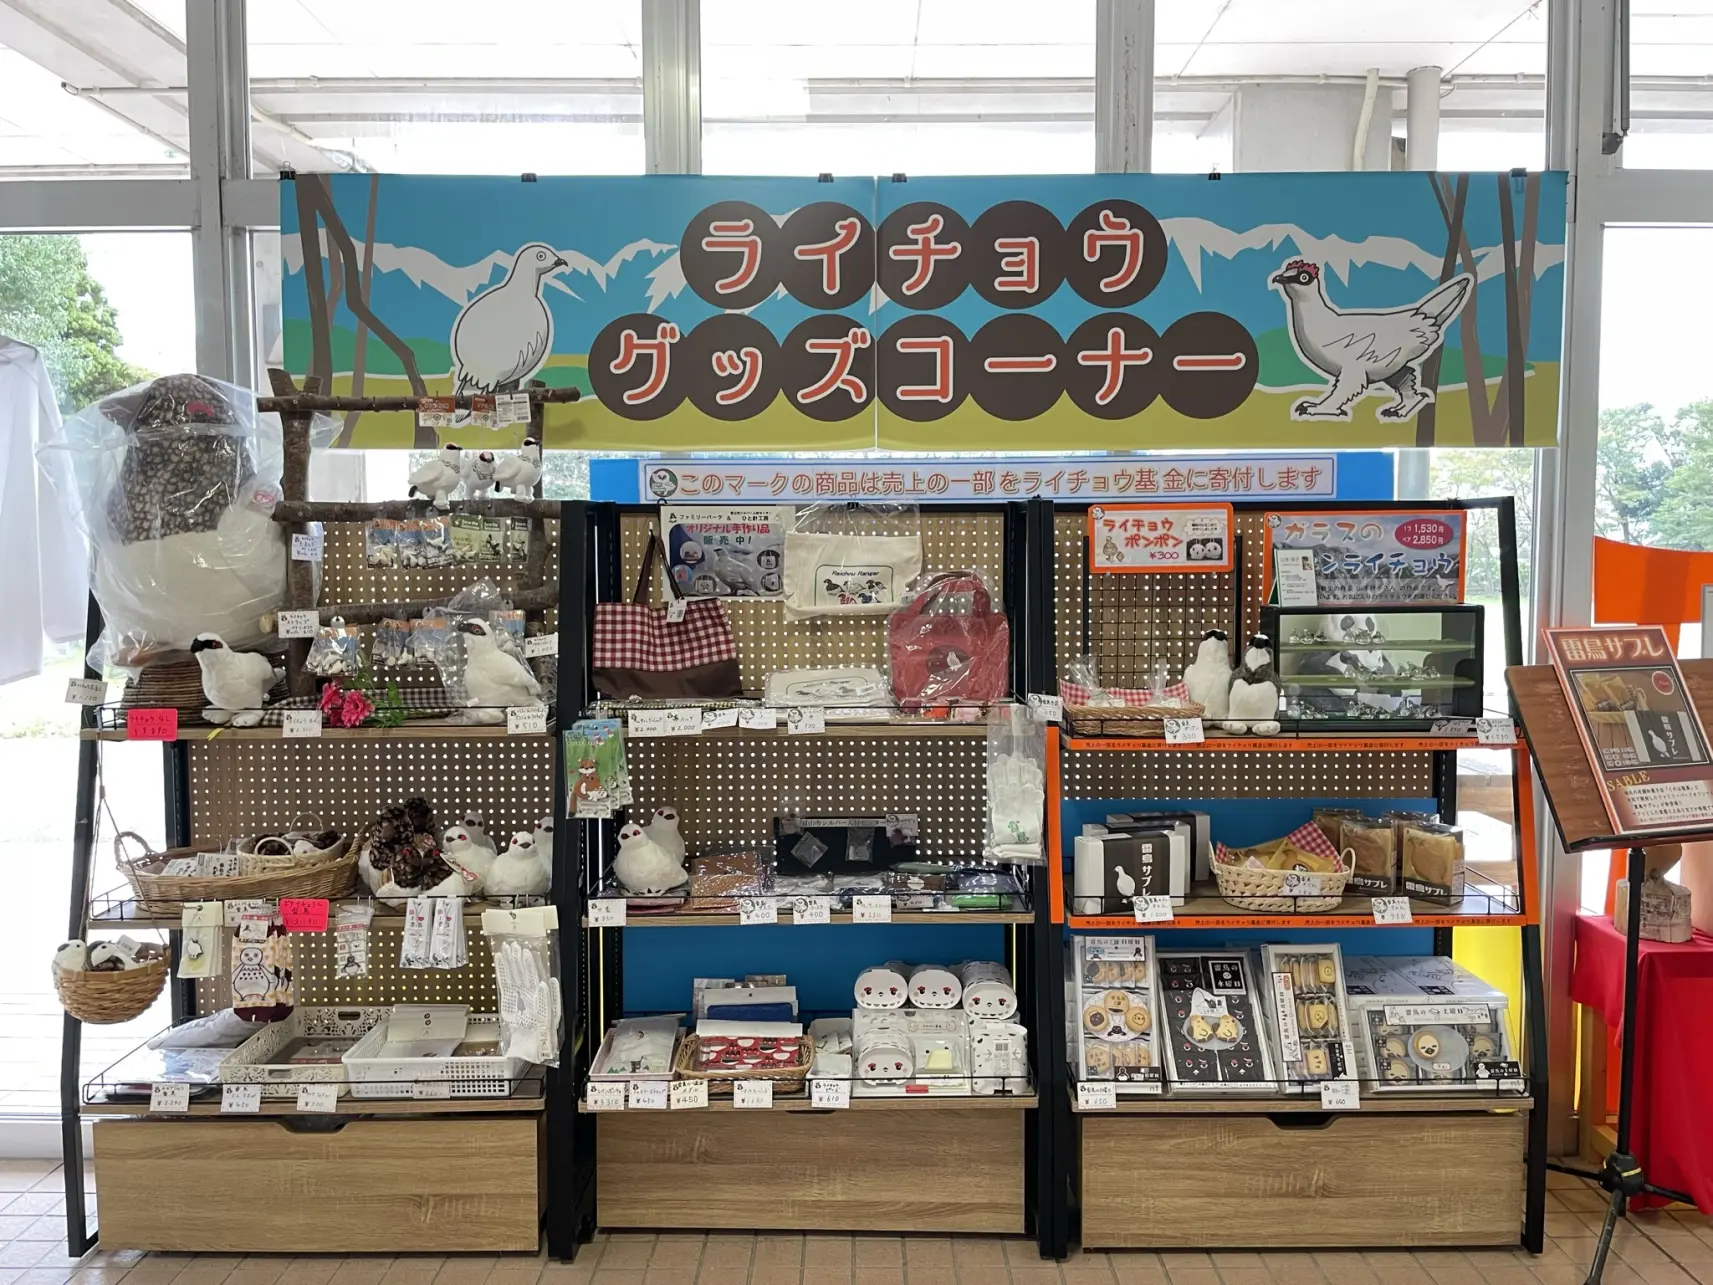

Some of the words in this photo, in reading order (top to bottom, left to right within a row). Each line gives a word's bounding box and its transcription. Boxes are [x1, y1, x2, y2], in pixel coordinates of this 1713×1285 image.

[701, 209, 1144, 295] ライチョウ
[609, 321, 1247, 406] グッズコーナー
[679, 467, 1321, 497] このマークの商品は売上の一部をライチョウ基金に寄付します
[686, 523, 771, 534] オリジナル手作り品
[1103, 516, 1175, 533] ライチョウ
[1284, 520, 1385, 542] ガラスの
[1414, 523, 1444, 534] 1,530円
[1124, 533, 1184, 549] ポンポン
[1412, 533, 1444, 545] 2,850円
[1560, 635, 1664, 661] 雷鳥サブレ
[1606, 770, 1650, 792] SABLE
[1140, 842, 1153, 897] 雷鳥サブレ
[1354, 877, 1389, 889] 鳥サブレ
